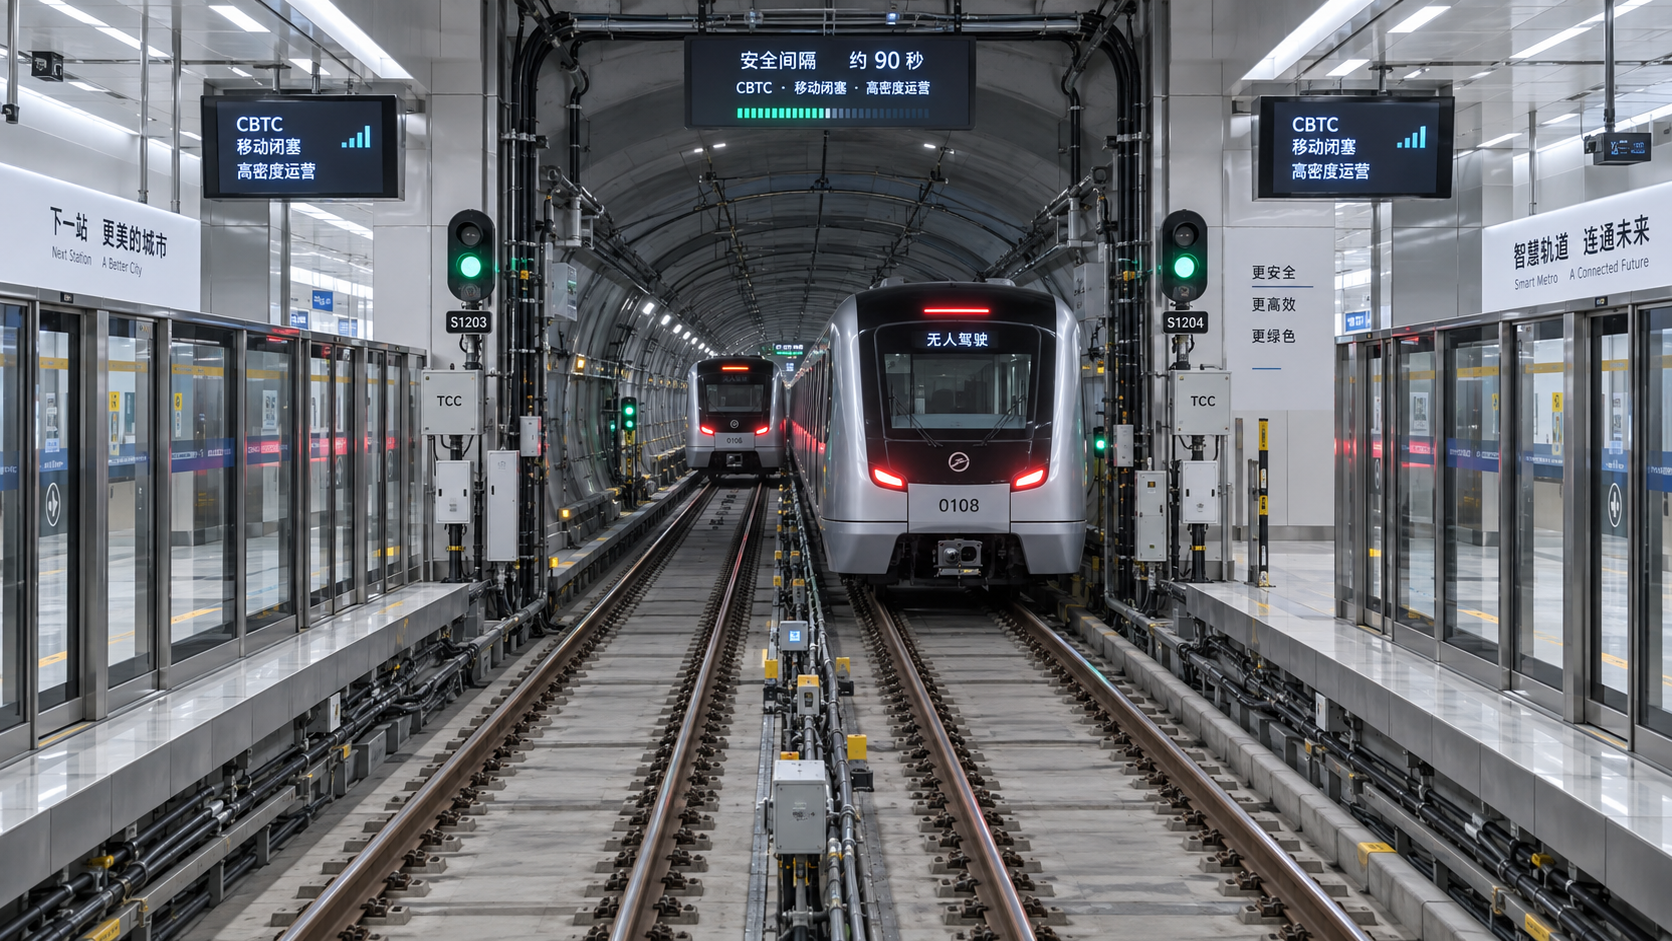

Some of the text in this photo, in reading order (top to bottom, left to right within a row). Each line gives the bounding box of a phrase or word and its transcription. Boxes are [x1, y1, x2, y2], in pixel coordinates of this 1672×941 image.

[740, 51, 924, 70] 安全间隔 约 90 秒
[736, 81, 773, 94] CBTC
[794, 80, 847, 95] 移动闭塞
[866, 80, 931, 95] 高密度运营
[236, 116, 283, 132] CBTC
[1292, 116, 1339, 132] CBTC
[236, 137, 301, 155] 移动闭塞
[1292, 137, 1356, 155] 移动闭塞
[236, 162, 316, 180] 高密度运营
[1291, 162, 1370, 180] 高密度运营
[50, 206, 168, 259] 下一站 更美的城市
[1514, 213, 1650, 270] 智慧轨道 连通未来
[51, 246, 143, 278] Next Station A Better City
[1251, 264, 1296, 280] 更安全
[1514, 255, 1650, 290] Smart Metro A Connected Future
[1251, 296, 1296, 312] 更高效
[450, 316, 488, 329] S1203
[1167, 316, 1205, 329] S1204
[926, 332, 988, 347] 无人驾驶
[1251, 328, 1296, 344] 更绿色
[436, 395, 462, 407] TCC
[1190, 395, 1216, 407] TCC
[938, 498, 980, 512] 0108
